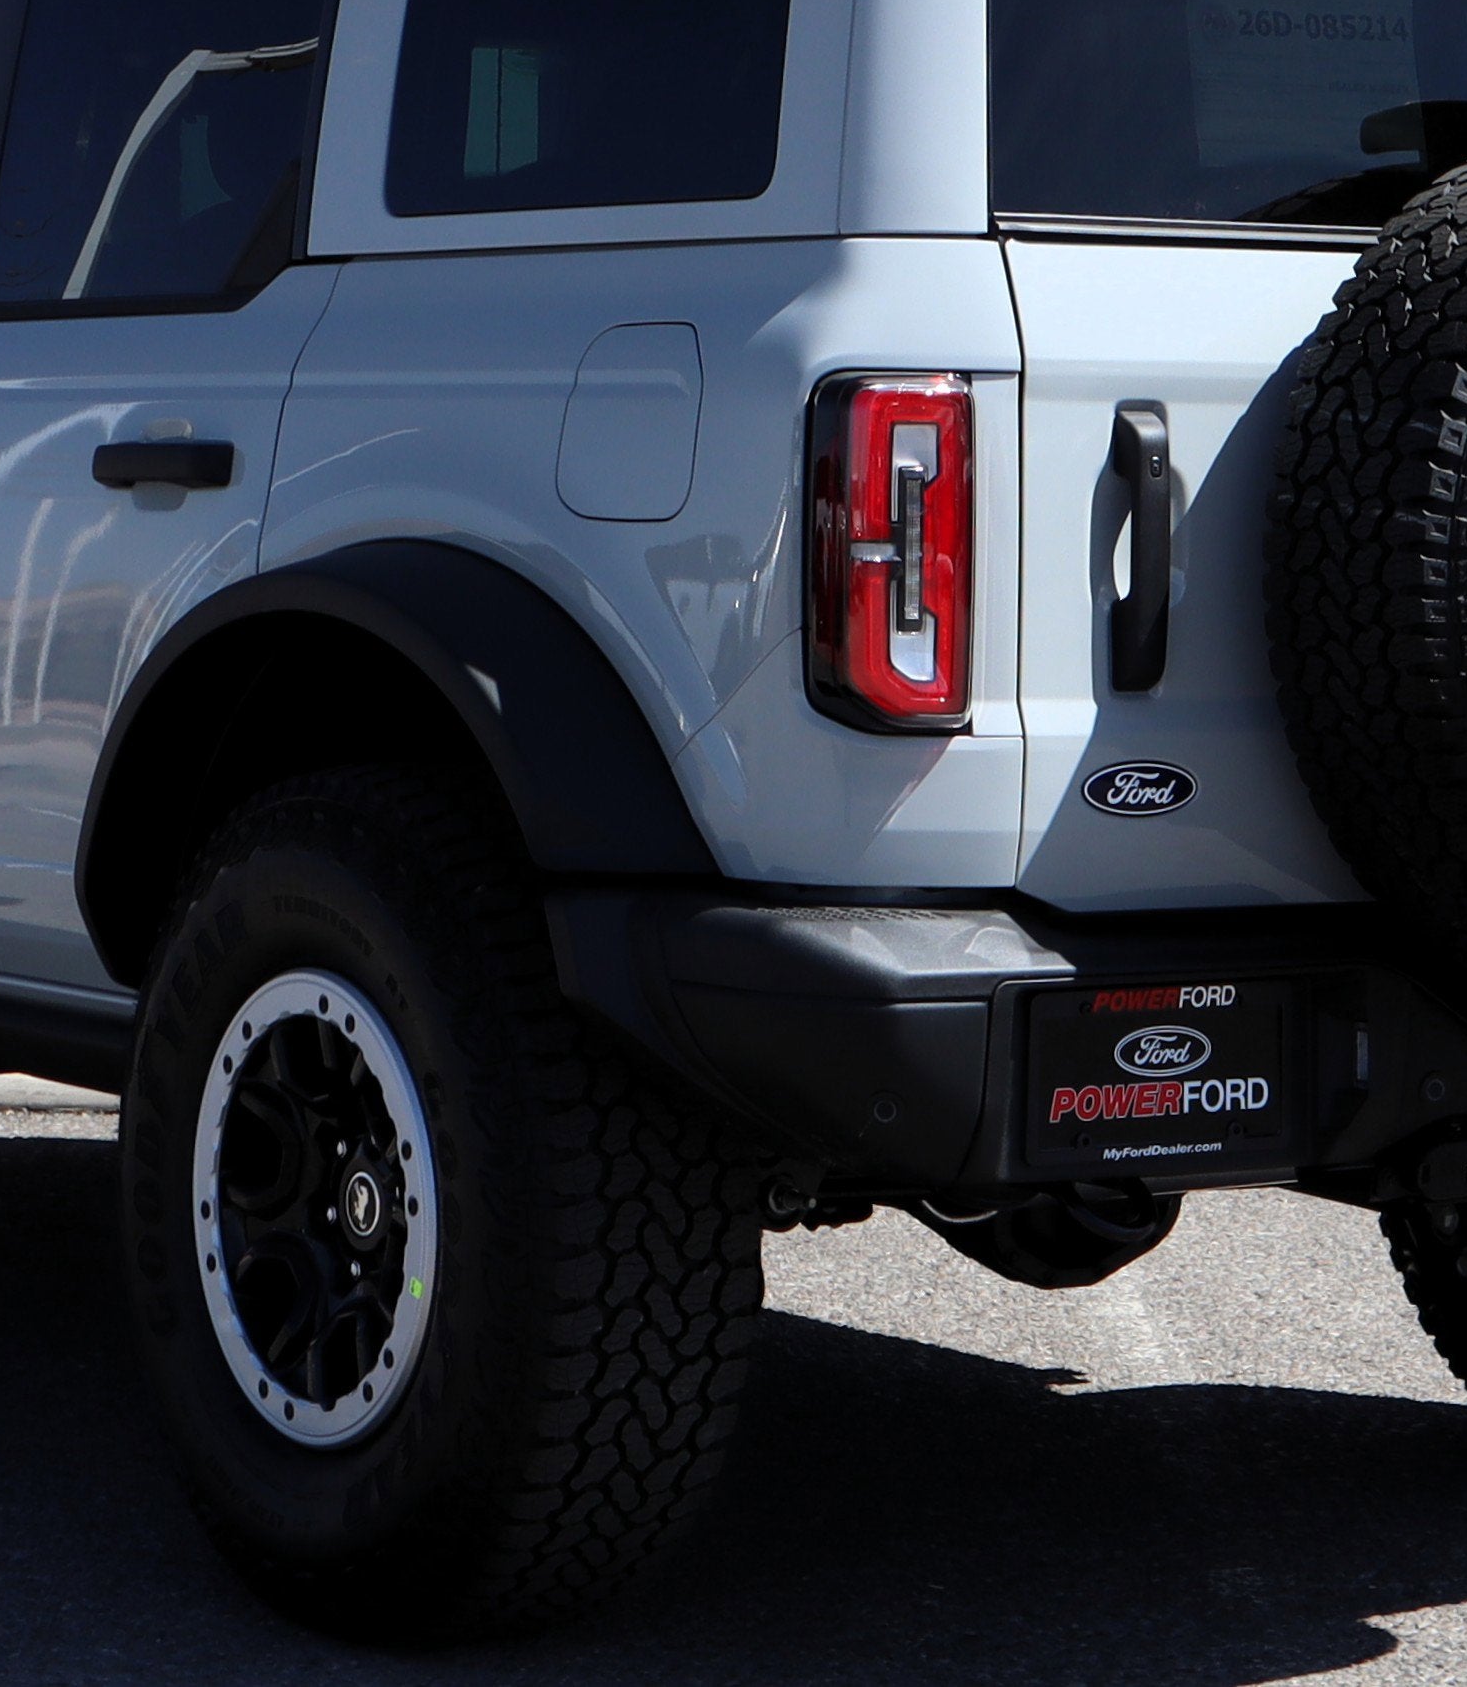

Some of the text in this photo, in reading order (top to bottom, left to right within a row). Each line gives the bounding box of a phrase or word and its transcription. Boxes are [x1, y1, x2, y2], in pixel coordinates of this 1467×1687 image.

[1237, 9, 1409, 41] 26D-085214
[1107, 771, 1176, 805] Ford
[1134, 1035, 1191, 1065] Ford
[1102, 1141, 1223, 1161] MyFordDealer.com
